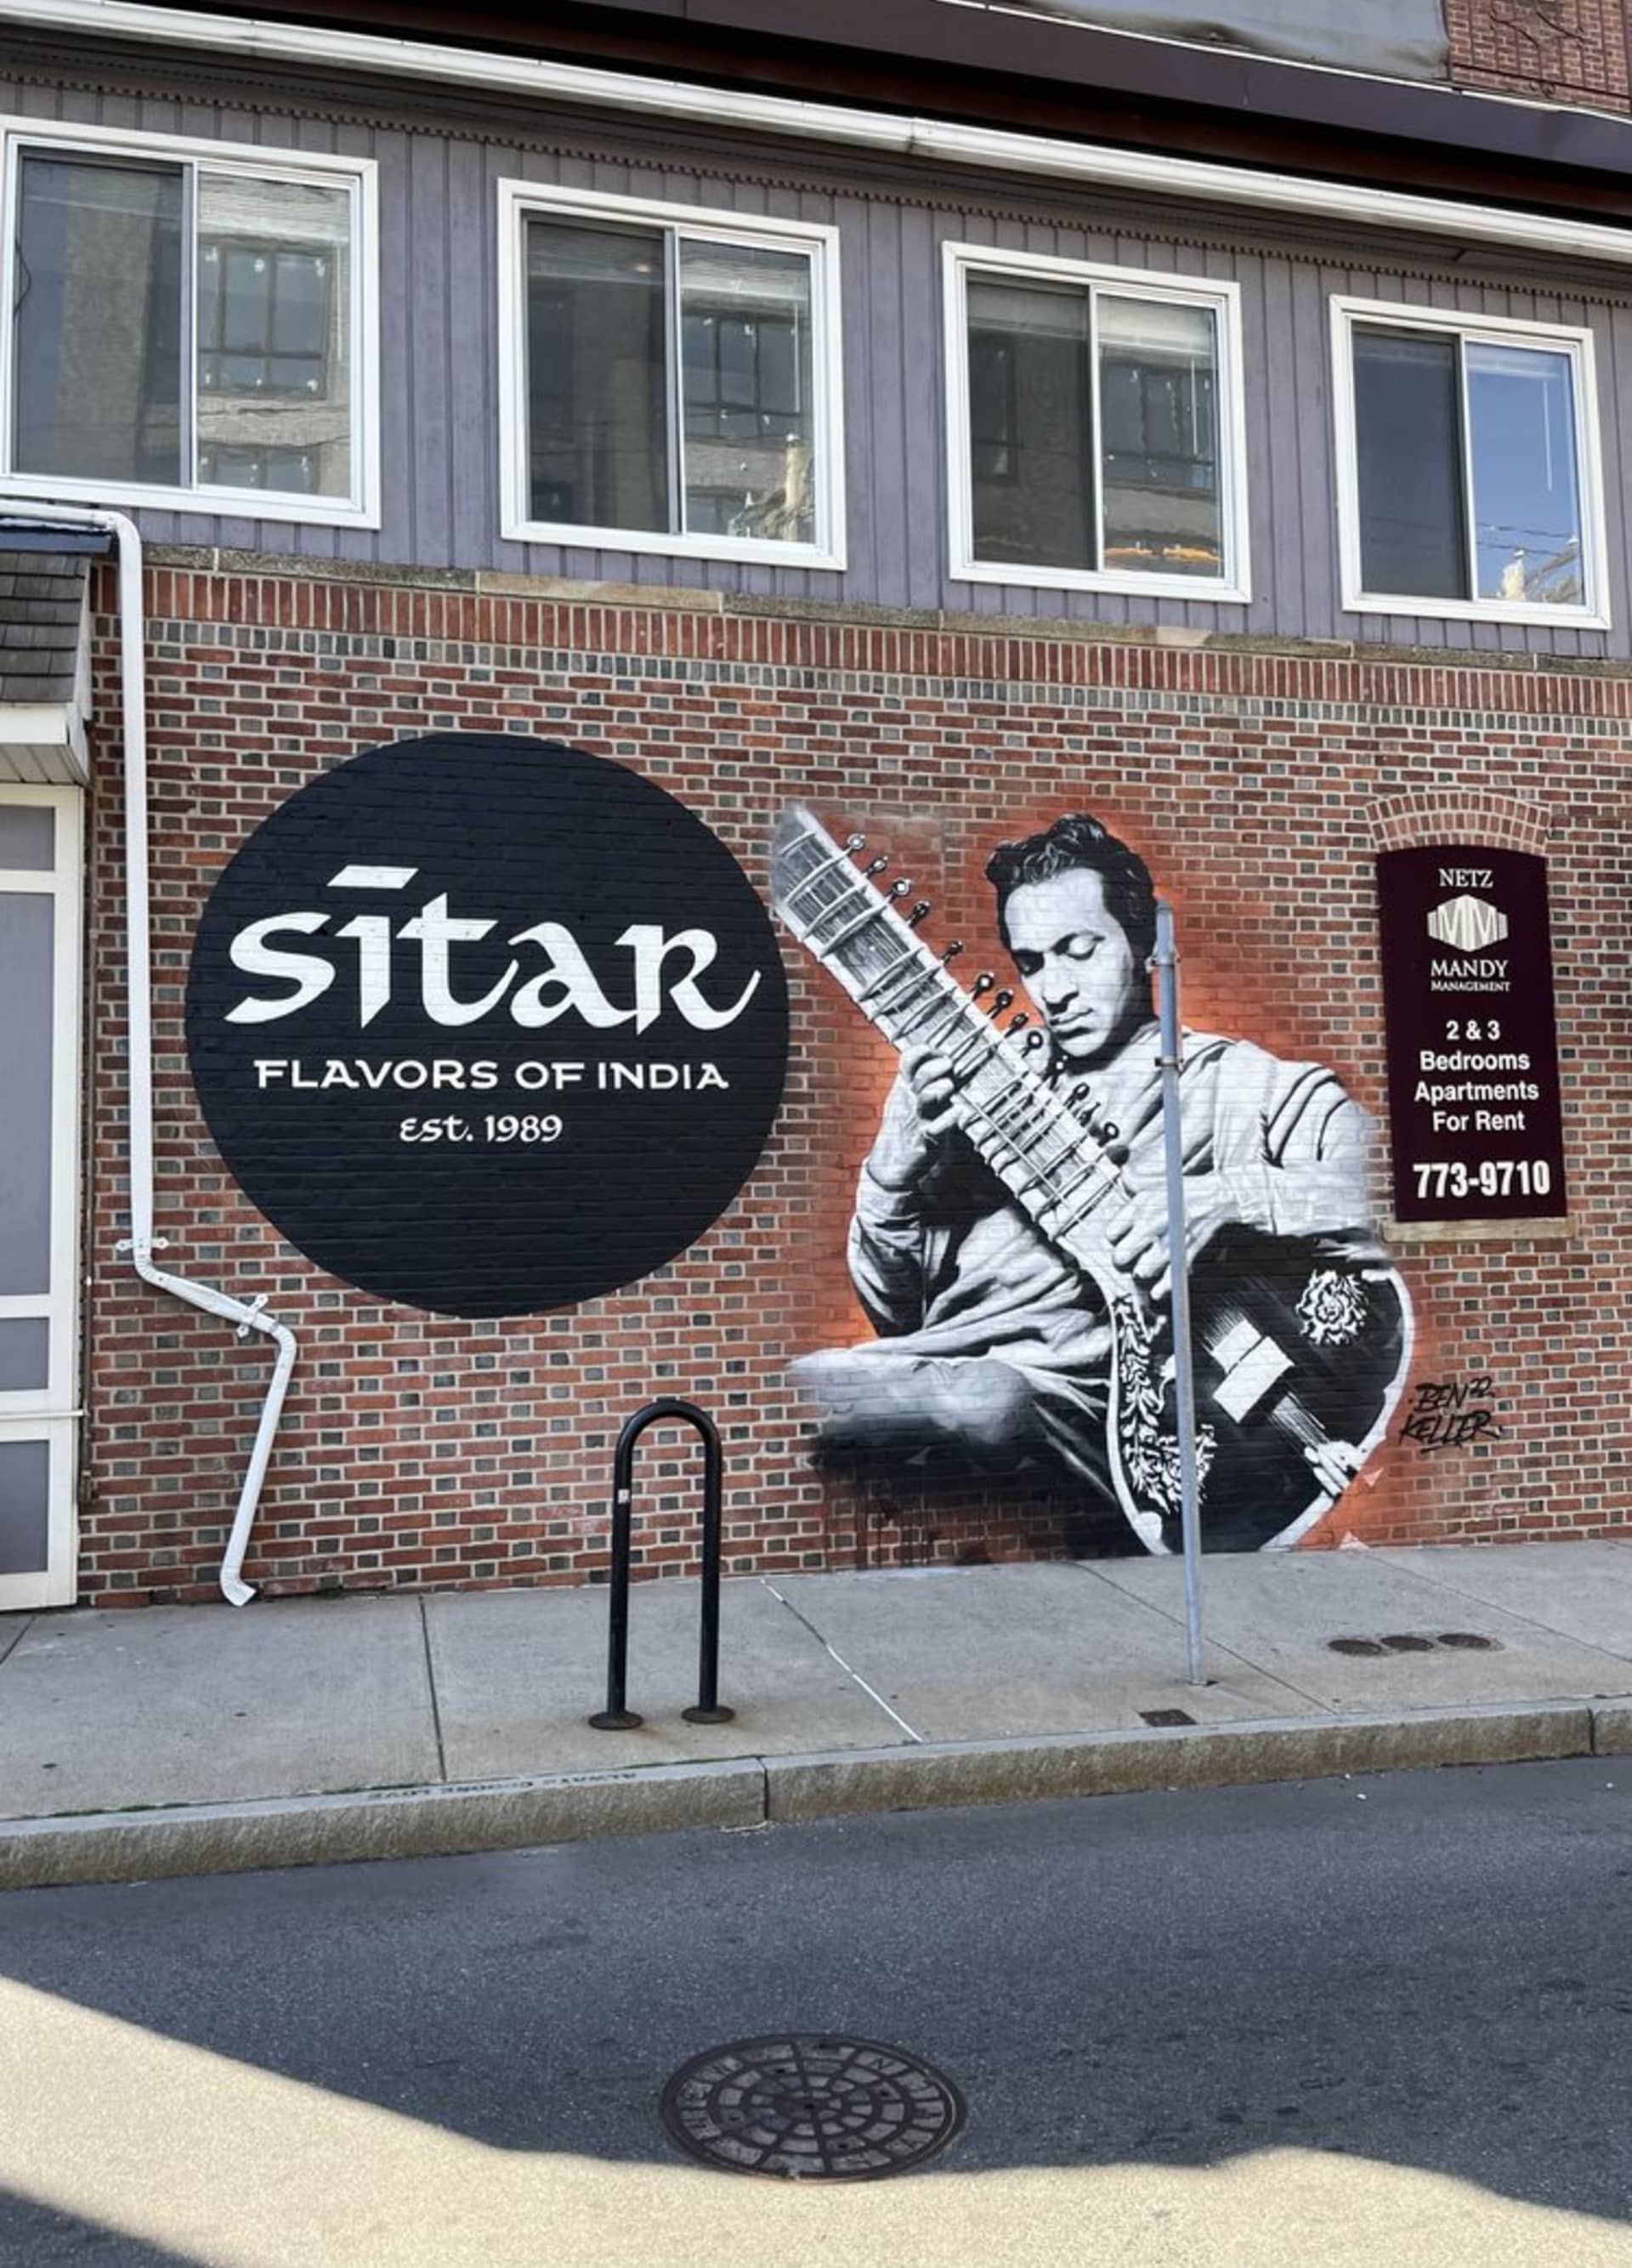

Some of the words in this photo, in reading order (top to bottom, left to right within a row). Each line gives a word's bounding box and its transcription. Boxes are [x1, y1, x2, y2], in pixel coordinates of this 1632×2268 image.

[1438, 868, 1493, 888] NETZ
[1431, 959, 1508, 978] MANDY
[1431, 980, 1511, 992] MANAGEMENT
[1446, 1020, 1459, 1040] 2
[1465, 1019, 1482, 1040] &
[1487, 1019, 1501, 1040] 3
[1420, 1050, 1531, 1071] Bedrooms
[253, 1059, 498, 1090] FLAVORS
[514, 1061, 586, 1091] OF
[598, 1062, 729, 1090] INDIA
[1414, 1080, 1539, 1107] Apartments
[484, 1114, 563, 1143] 1989
[1432, 1110, 1470, 1131] For
[1475, 1109, 1527, 1131] Rent
[1413, 1160, 1550, 1199] 773-9710
[1414, 1382, 1469, 1412] BEN
[1399, 1409, 1501, 1444] KELLER
